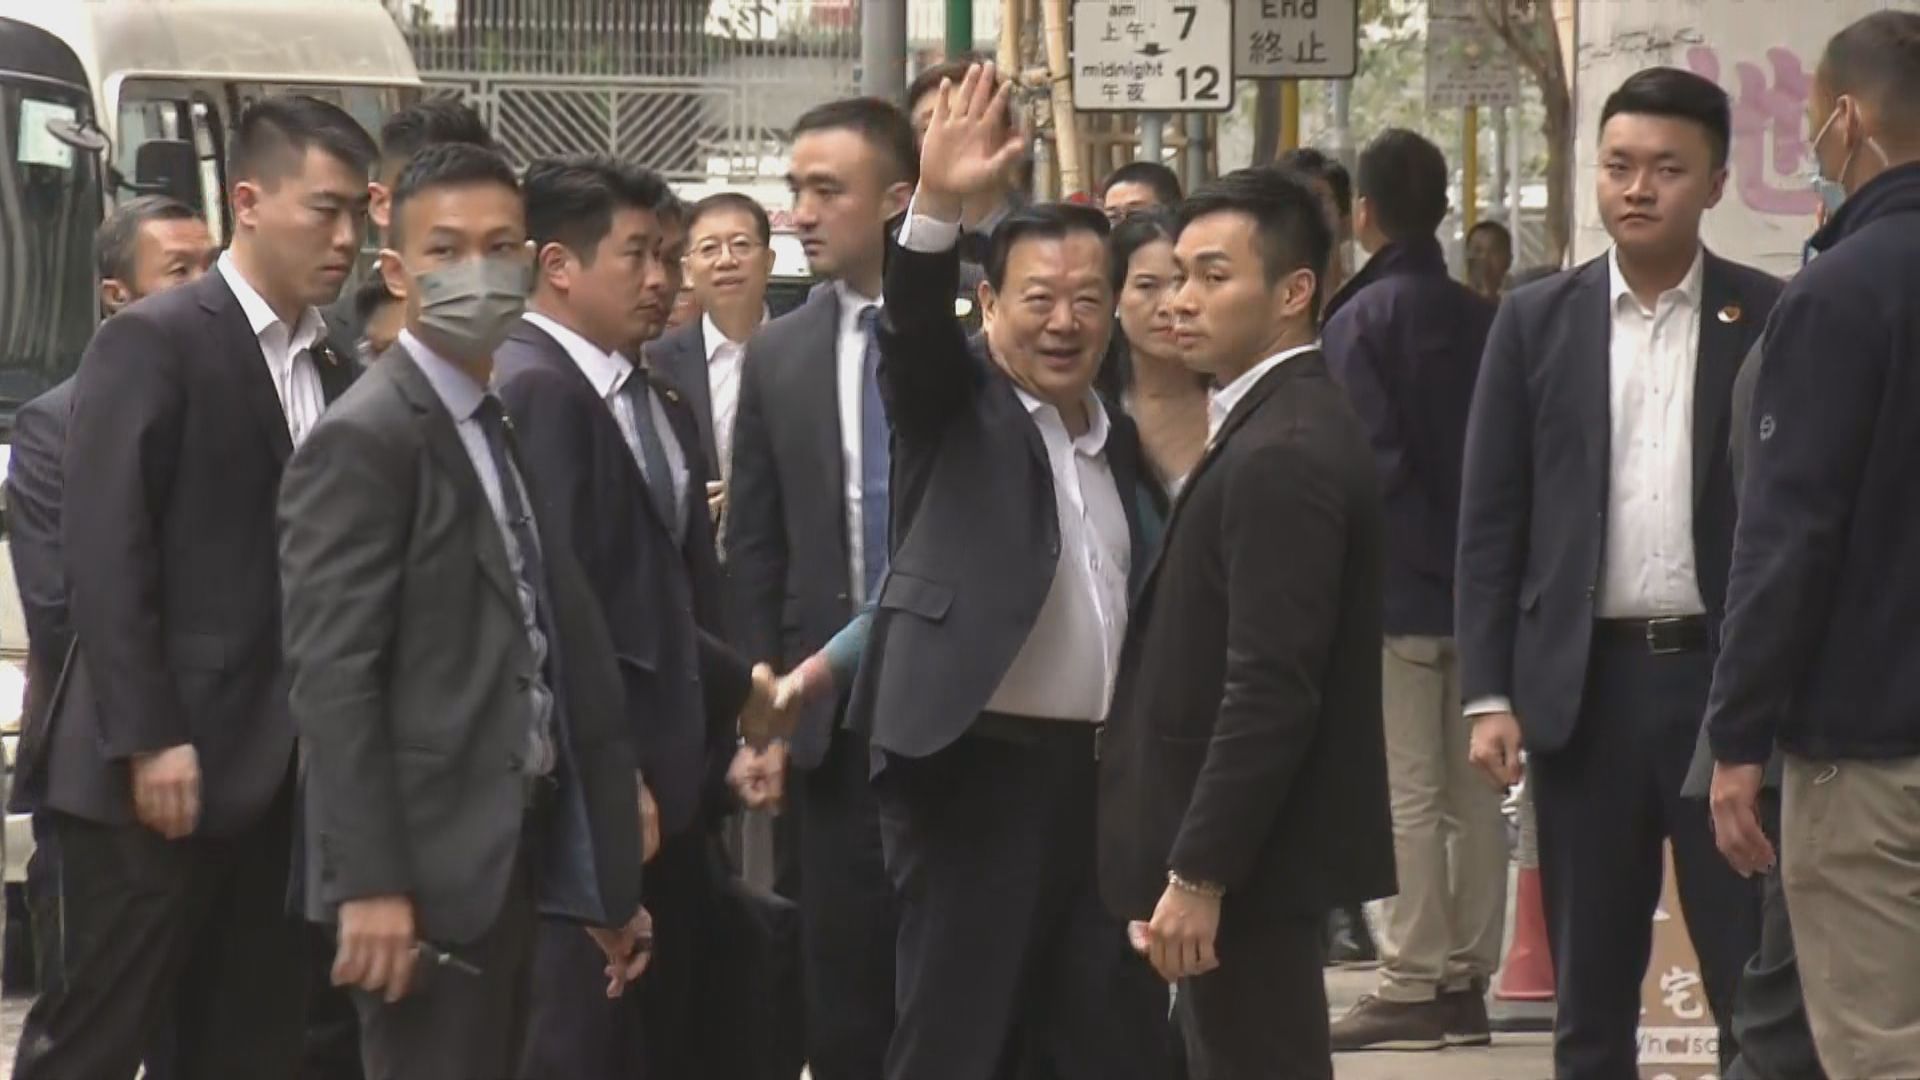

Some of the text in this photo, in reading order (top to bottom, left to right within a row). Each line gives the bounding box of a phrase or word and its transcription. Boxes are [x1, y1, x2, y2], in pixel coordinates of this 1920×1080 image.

[1109, 3, 1136, 17] am
[1261, 0, 1318, 19] End
[1100, 21, 1146, 42] 上午
[1173, 6, 1197, 41] 7
[1249, 30, 1328, 64] 終止
[1081, 61, 1164, 78] midnight
[1101, 81, 1146, 101] 午夜
[1174, 66, 1220, 101] 12
[1660, 965, 1703, 1019] 宅
